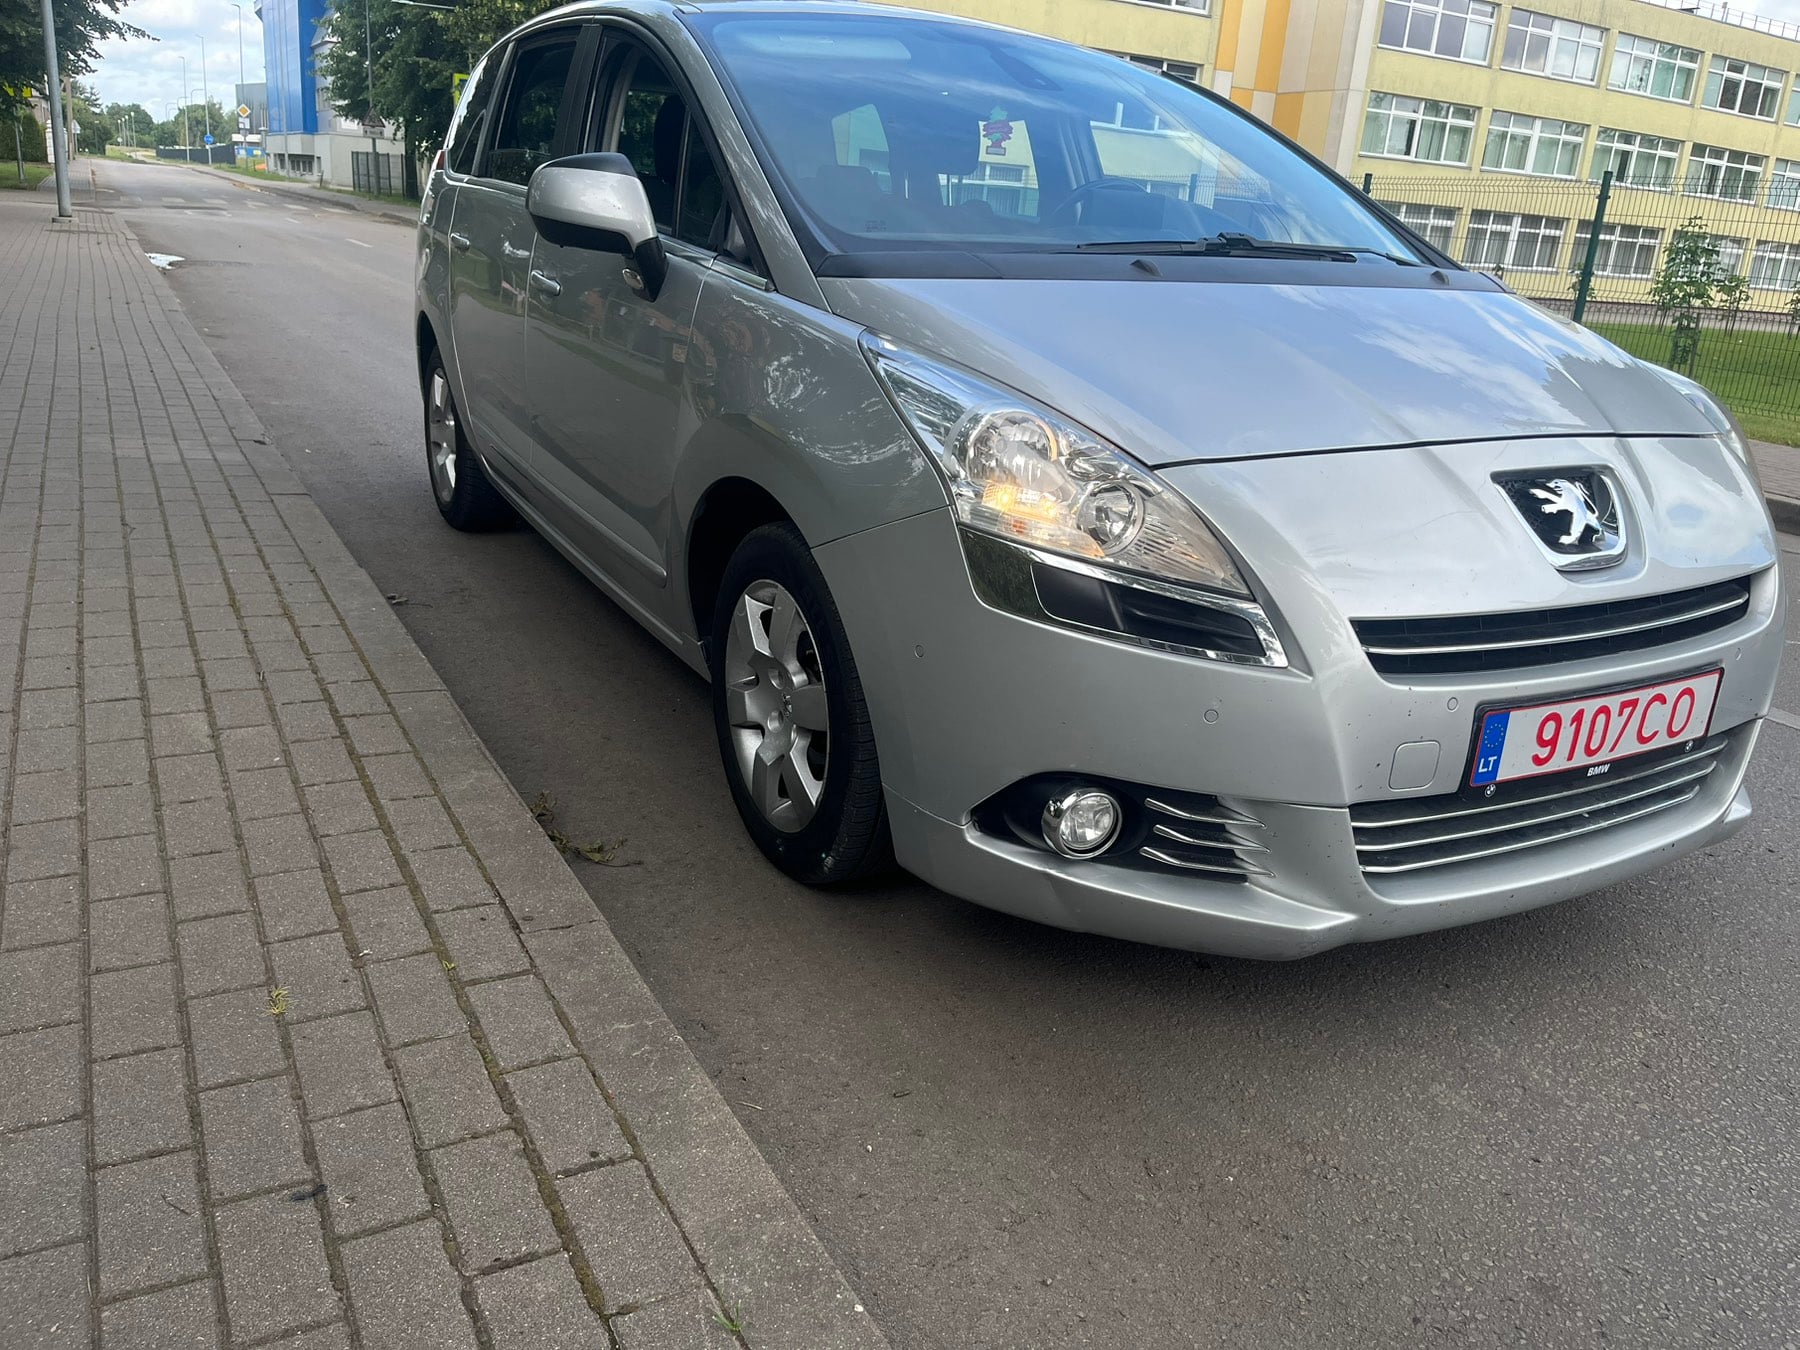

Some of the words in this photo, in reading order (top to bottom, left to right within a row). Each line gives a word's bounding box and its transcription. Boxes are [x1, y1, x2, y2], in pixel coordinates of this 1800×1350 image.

[1532, 687, 1695, 766] 9107CO
[1478, 756, 1497, 773] LT
[1587, 763, 1610, 777] BMW
